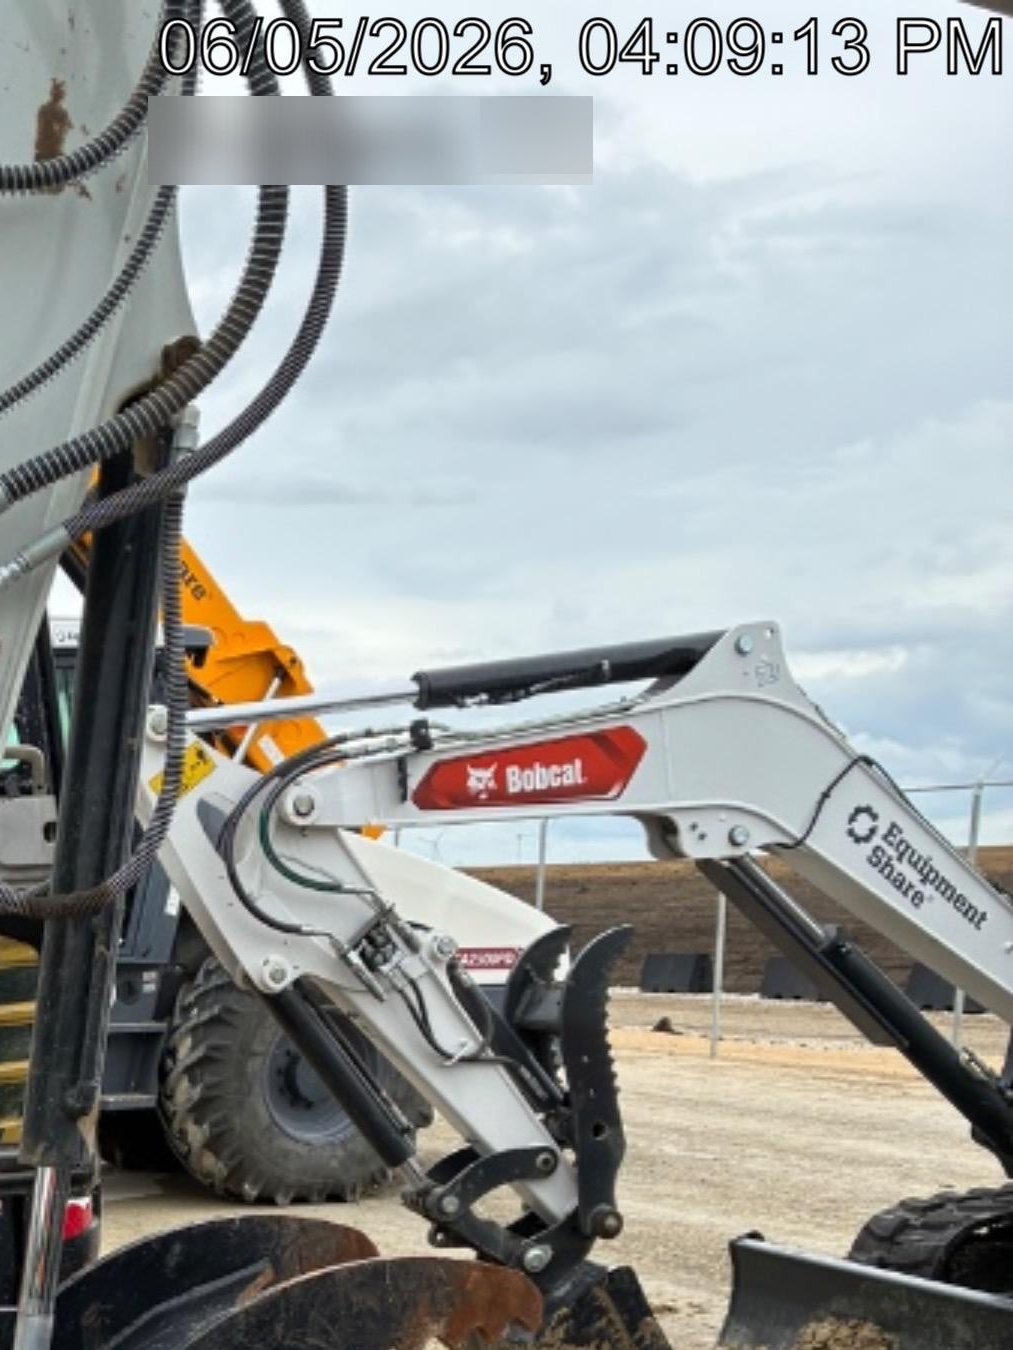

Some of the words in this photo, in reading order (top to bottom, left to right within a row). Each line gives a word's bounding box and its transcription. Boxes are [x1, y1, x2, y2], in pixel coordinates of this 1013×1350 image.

[506, 758, 584, 794] Bobcat
[867, 845, 925, 909] Share
[882, 821, 988, 931] Equipment
